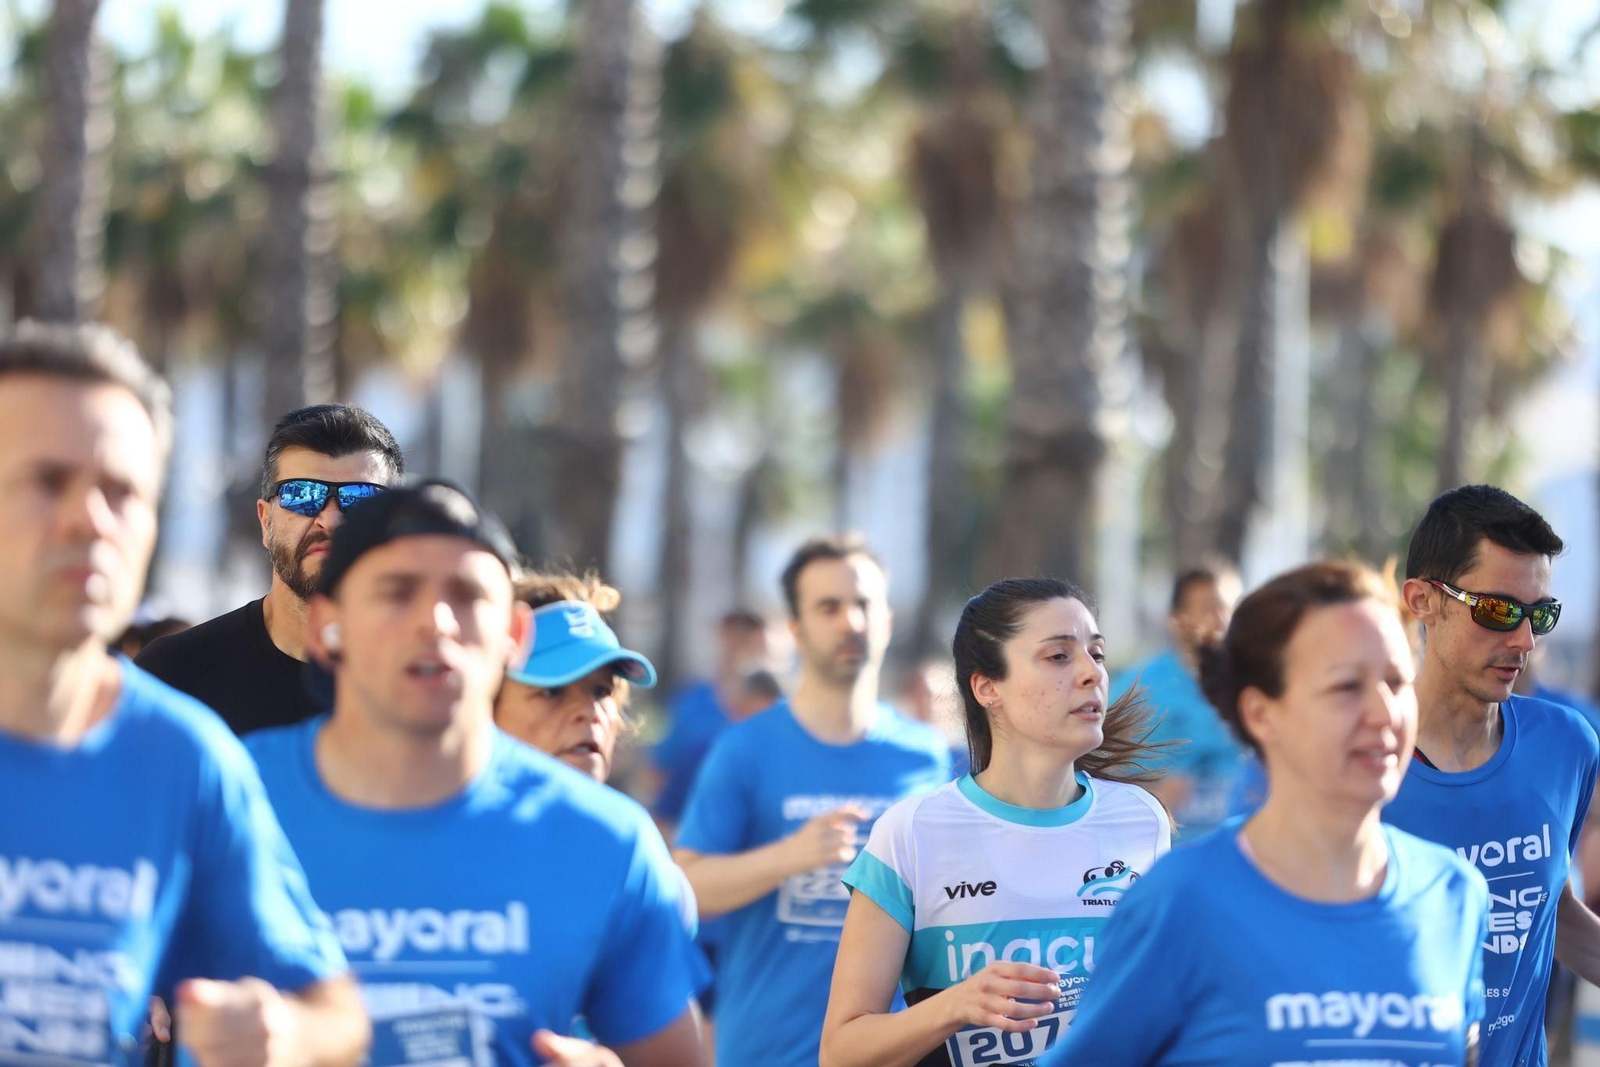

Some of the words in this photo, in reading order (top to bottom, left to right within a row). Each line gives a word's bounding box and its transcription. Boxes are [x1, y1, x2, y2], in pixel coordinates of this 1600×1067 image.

[945, 880, 997, 899] vive
[334, 900, 529, 962] ayoral
[1057, 976, 1089, 989] ayor
[969, 1016, 1074, 1065] 207
